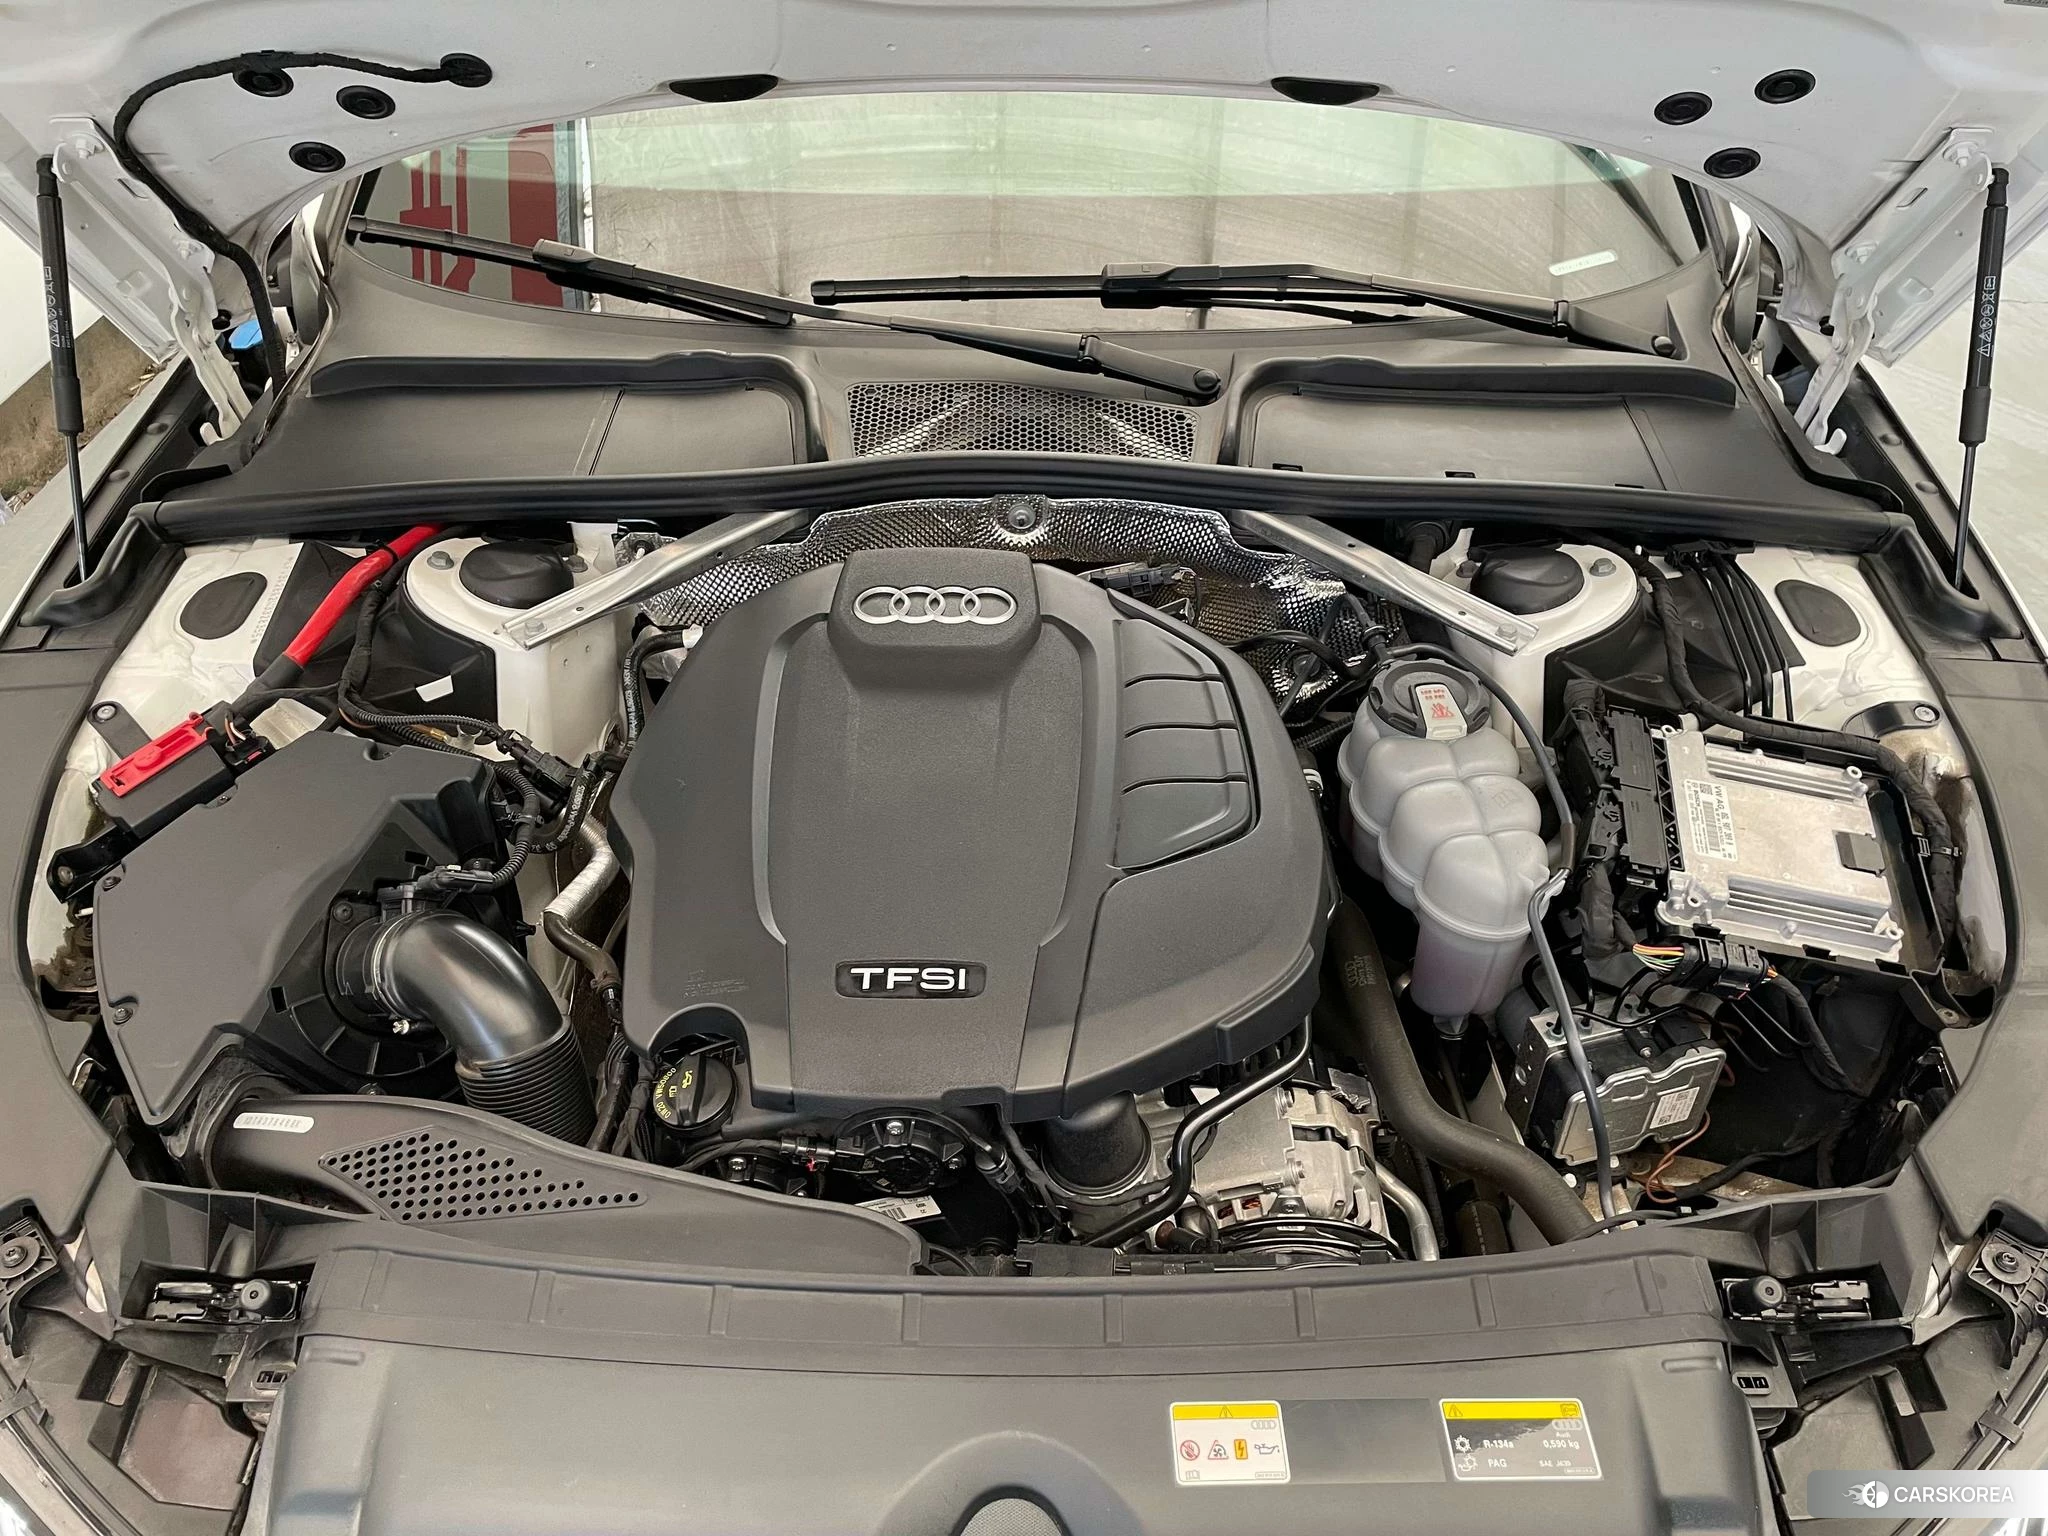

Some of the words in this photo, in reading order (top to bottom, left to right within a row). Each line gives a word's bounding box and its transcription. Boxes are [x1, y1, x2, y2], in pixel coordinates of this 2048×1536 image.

[1715, 785, 1723, 799] VW
[1716, 799, 1725, 810] AG
[850, 966, 966, 990] TFSI
[1483, 1439, 1515, 1449] R-134a
[1543, 1439, 1567, 1449] 0,590
[1568, 1439, 1581, 1451] kg
[1488, 1458, 1508, 1468] PAG
